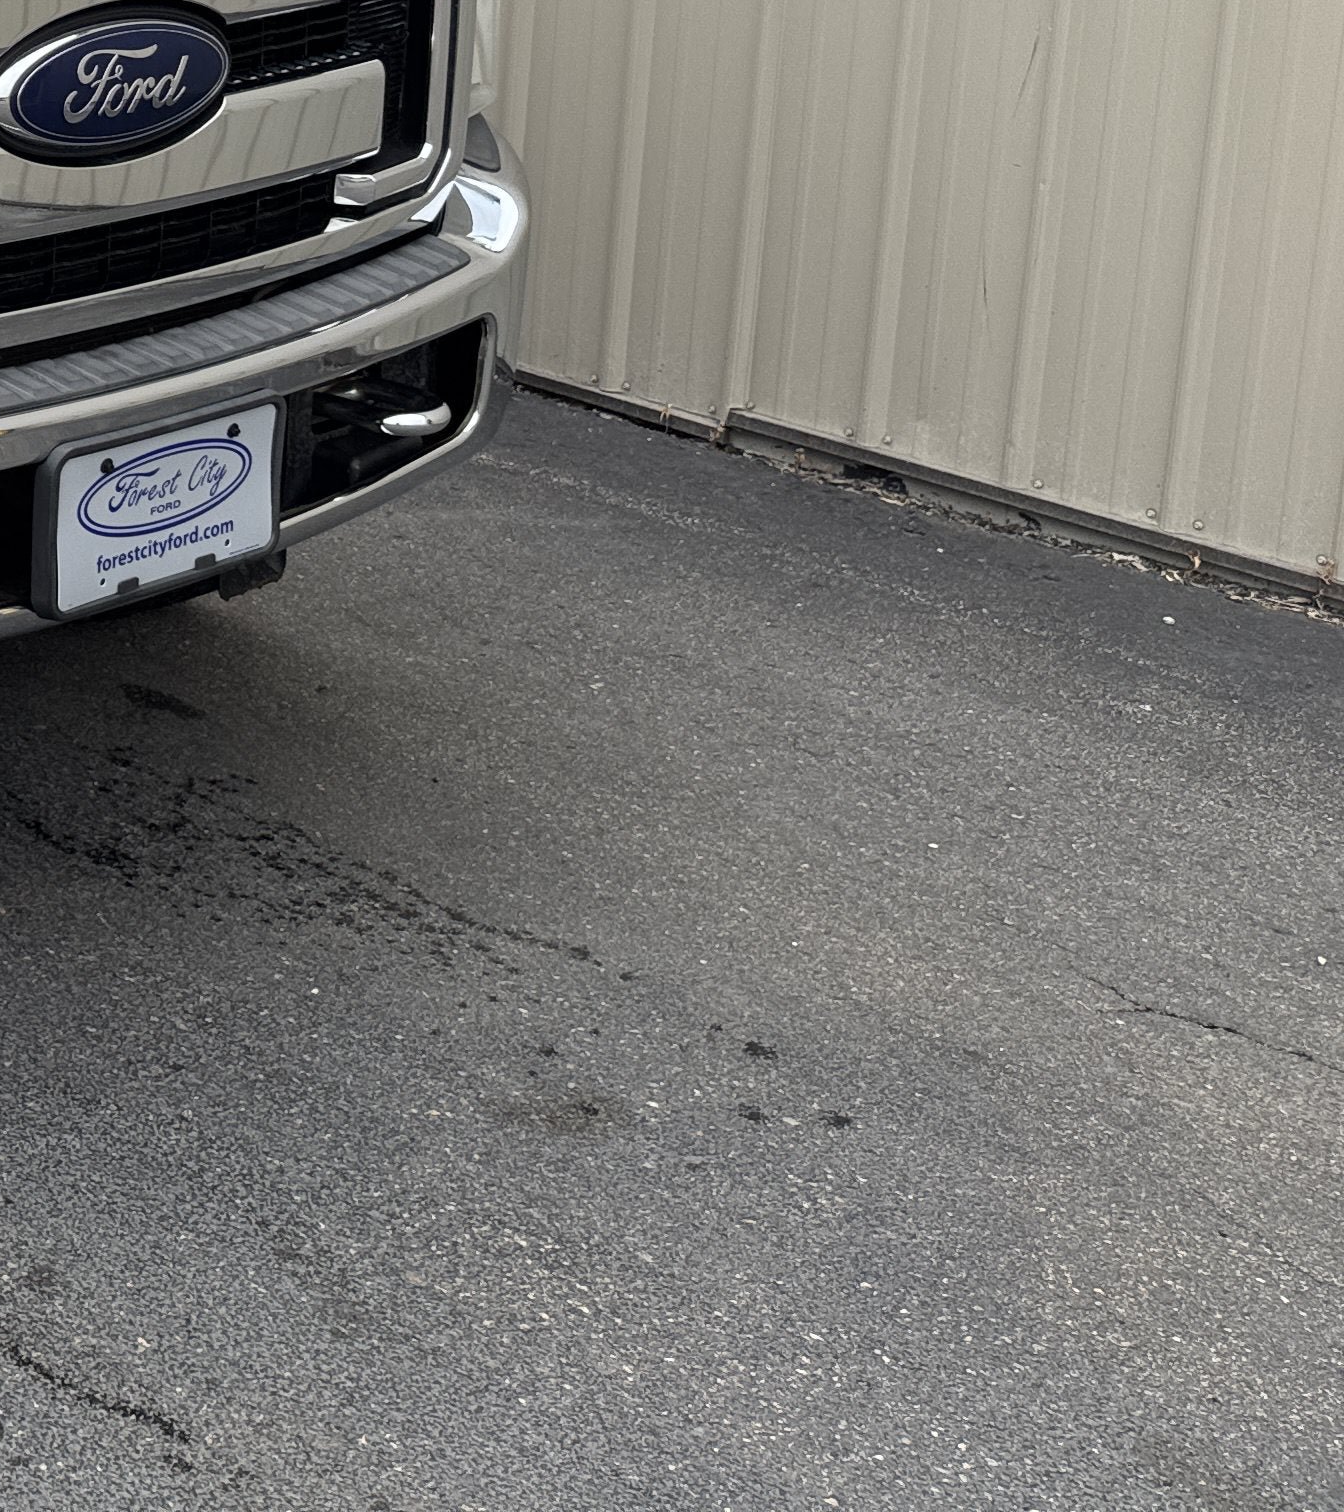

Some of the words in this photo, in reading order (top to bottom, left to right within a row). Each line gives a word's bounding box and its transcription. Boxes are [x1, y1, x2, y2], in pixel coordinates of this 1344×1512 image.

[63, 43, 190, 124] Ford
[108, 467, 182, 512] Forest
[187, 454, 227, 496] City
[150, 499, 182, 515] FORD
[96, 519, 234, 573] forestcityford.com
